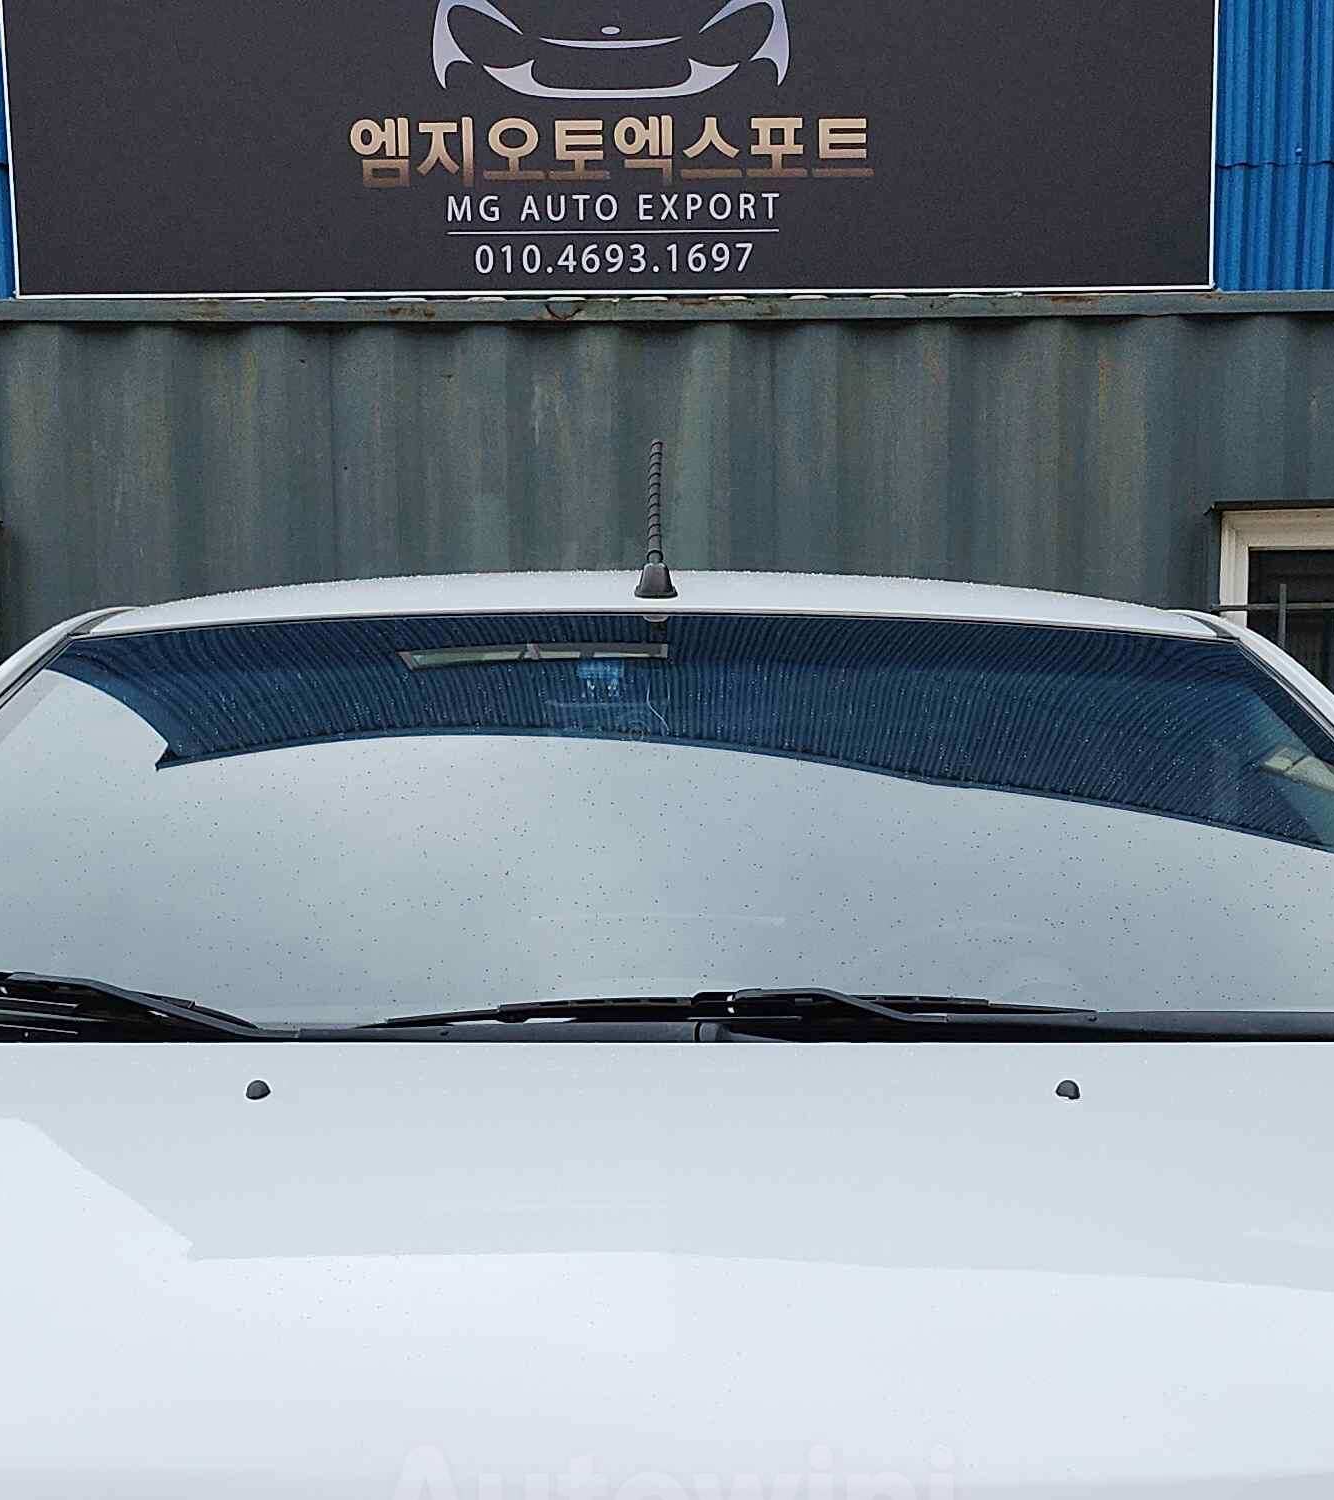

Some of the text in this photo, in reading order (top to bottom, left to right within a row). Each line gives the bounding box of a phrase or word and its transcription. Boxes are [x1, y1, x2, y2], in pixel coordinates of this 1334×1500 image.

[350, 115, 874, 187] 엠지오토엑스포트
[447, 193, 780, 222] MG AUTO EXPORT
[474, 242, 754, 274] 010.4693.1697
